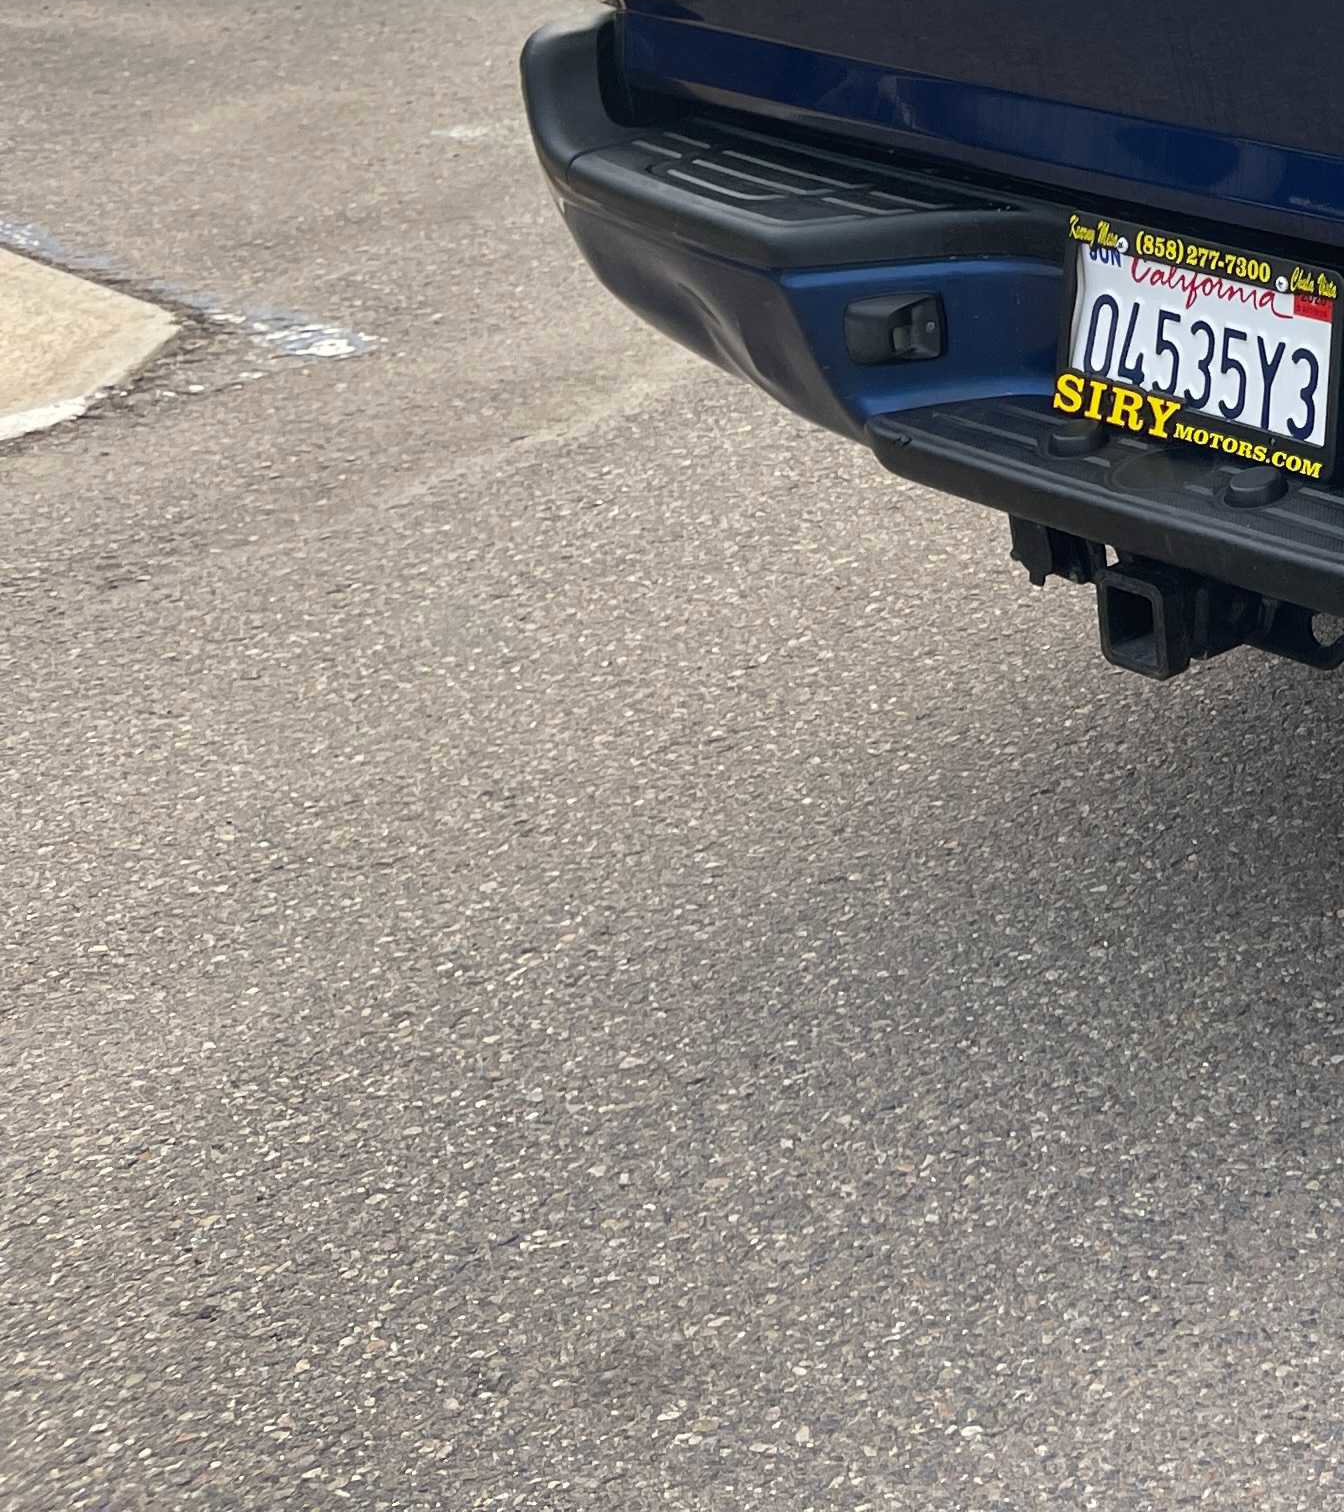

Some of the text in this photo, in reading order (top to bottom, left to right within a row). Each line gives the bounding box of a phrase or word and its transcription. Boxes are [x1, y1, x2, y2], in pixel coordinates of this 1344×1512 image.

[1130, 255, 1294, 319] California
[1135, 230, 1271, 283] (858) 277-7300
[1083, 293, 1319, 441] 04535Y3
[1052, 373, 1181, 439] SIRY
[1172, 421, 1324, 479] MOTORS.COM
